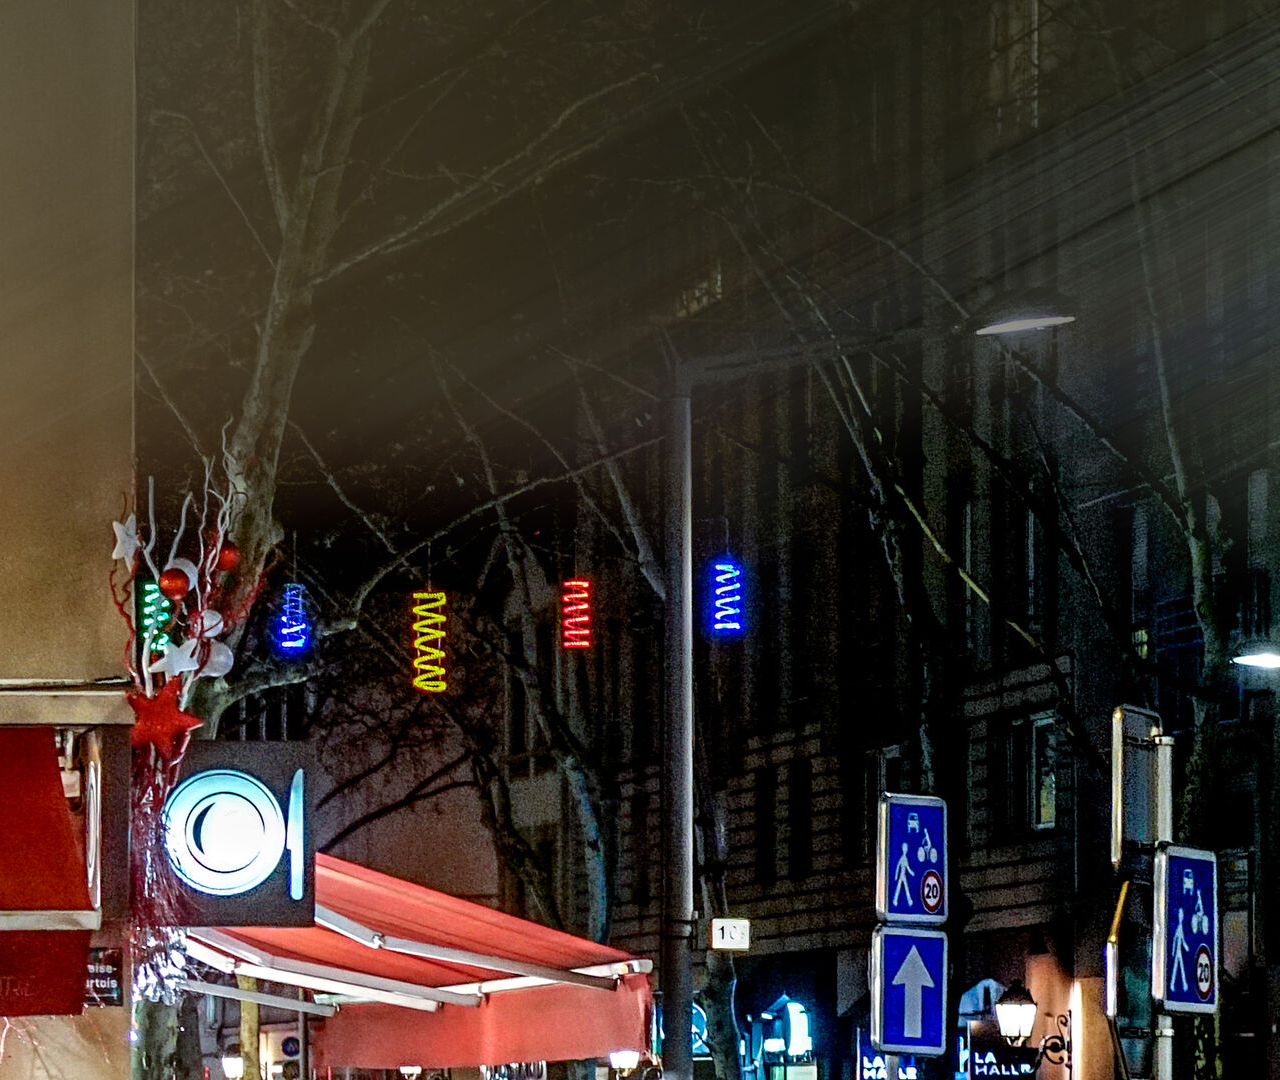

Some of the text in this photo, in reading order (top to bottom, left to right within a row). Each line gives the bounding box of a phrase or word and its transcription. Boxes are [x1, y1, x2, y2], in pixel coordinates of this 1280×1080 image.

[926, 884, 938, 898] 20
[1198, 963, 1209, 983] 20
[863, 1056, 885, 1069] LA
[975, 1052, 997, 1064] LA
